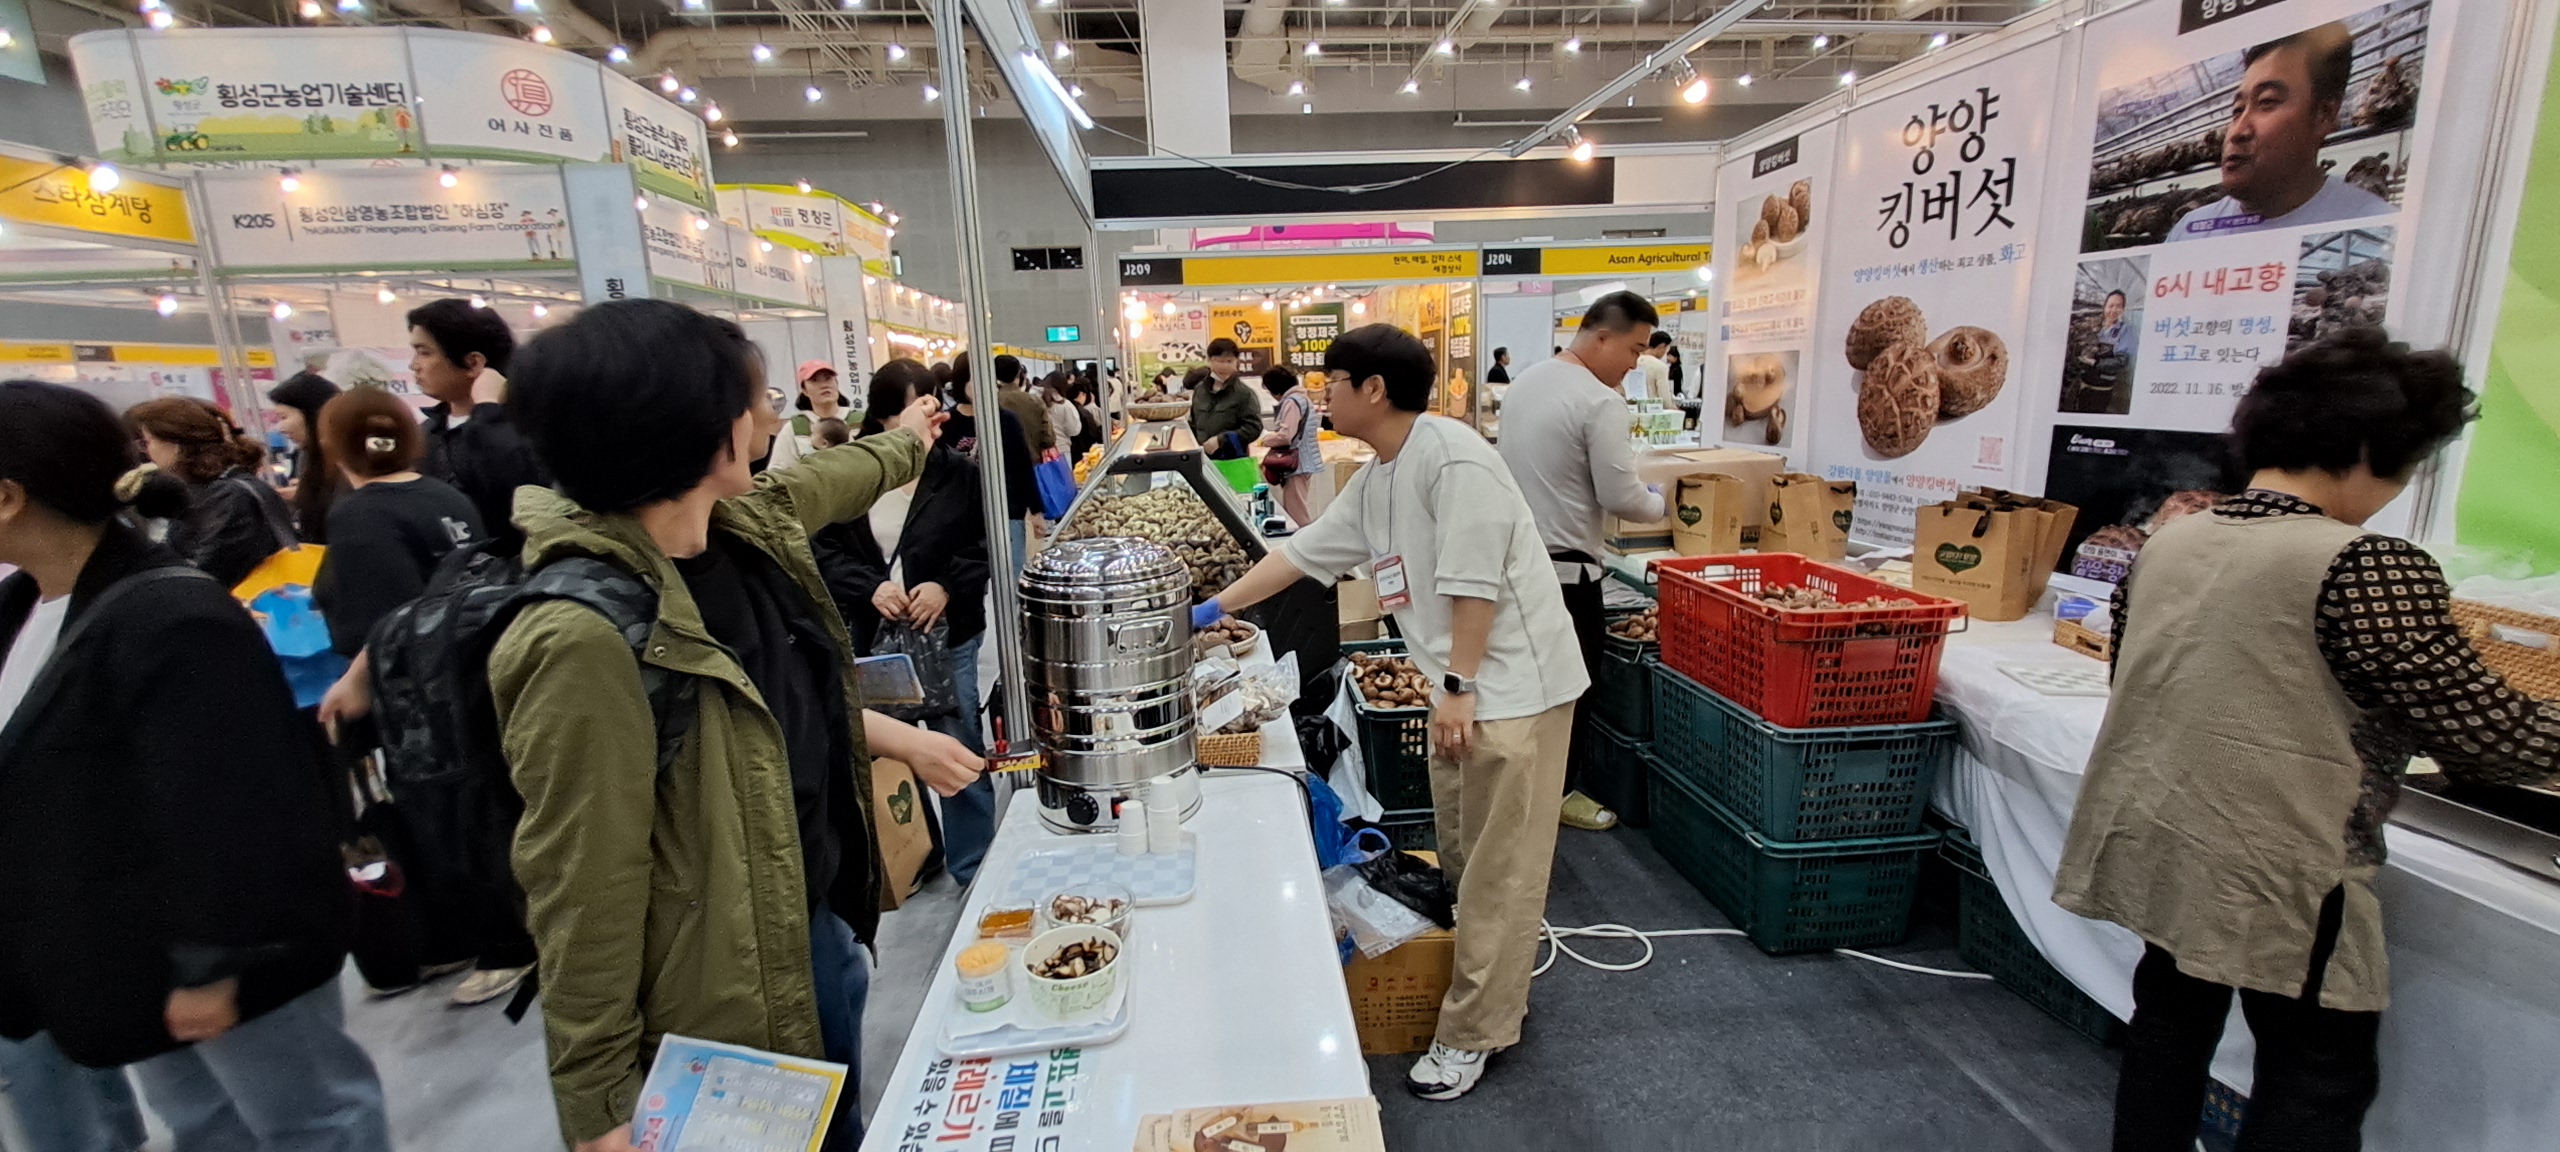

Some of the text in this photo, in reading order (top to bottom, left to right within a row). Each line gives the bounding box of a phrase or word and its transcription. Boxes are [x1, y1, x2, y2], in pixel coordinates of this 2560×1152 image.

[216, 82, 407, 108] 횡성군농업기술센터
[487, 117, 574, 142] 어사진품
[1903, 87, 2000, 175] 양양
[33, 182, 153, 224] 스타삼계탕
[300, 203, 449, 223] 횡성인삼영농조합법인
[1877, 157, 2016, 249] 킹버섯
[233, 213, 276, 229] K205
[797, 208, 833, 226] 평창군
[429, 224, 467, 234] Ginseng
[469, 223, 496, 232] Farm
[497, 222, 557, 233] Corporation
[1431, 254, 1445, 264] 감자
[1448, 254, 1461, 263] 스낵
[1486, 254, 1512, 265] J204
[1608, 254, 1635, 264] Asan
[1638, 251, 1700, 266] Agricultural
[1853, 263, 1916, 283] 양양킹버섯에서
[1918, 257, 1954, 275] 생산하는
[1999, 243, 2027, 264] 화고
[1124, 263, 1151, 276] J209
[2154, 262, 2286, 298] 6시 내고향
[605, 277, 625, 300] 횡
[1296, 326, 1339, 339] 청정제주
[2154, 315, 2233, 338] 버섯고향의
[2160, 345, 2210, 362] 표고로
[842, 320, 863, 412] 횡성군농업기술
[2150, 382, 2179, 395] 2022.
[2231, 383, 2247, 397] 방
[920, 1058, 952, 1093] 있을
[994, 1060, 1039, 1131] 체질에
[913, 1099, 938, 1117] 수
